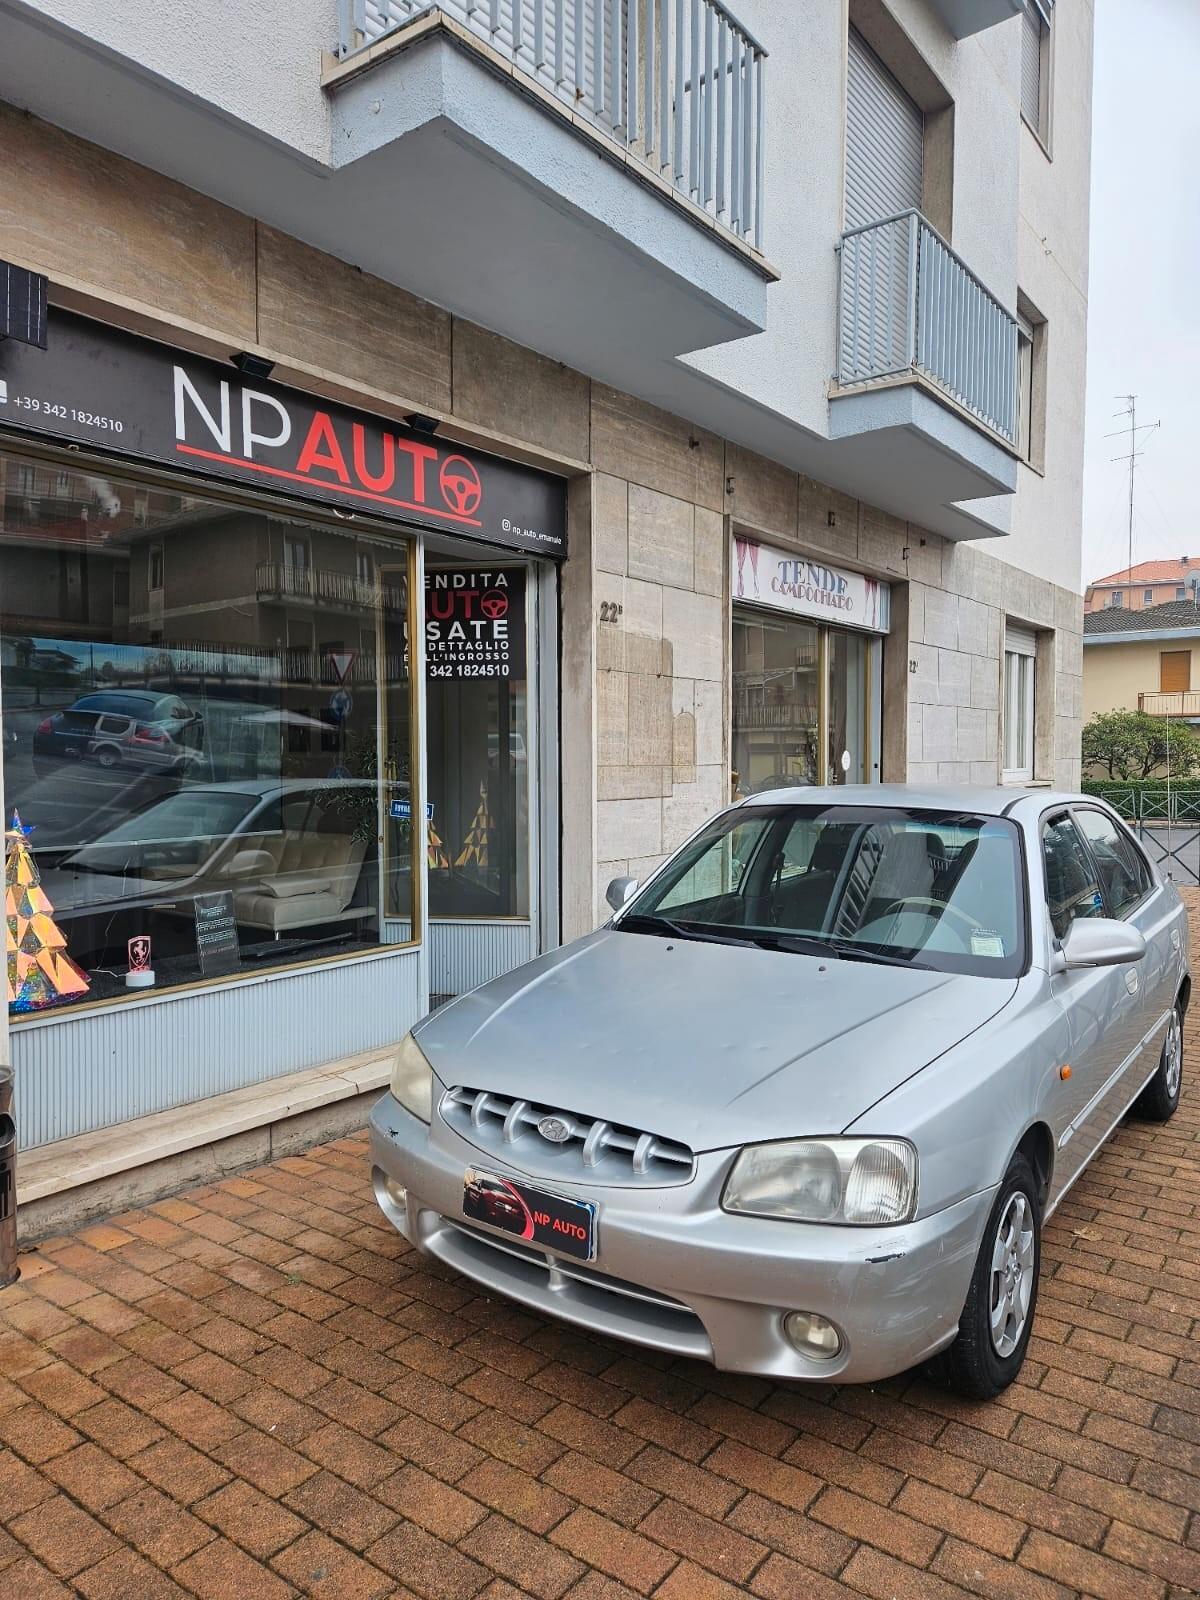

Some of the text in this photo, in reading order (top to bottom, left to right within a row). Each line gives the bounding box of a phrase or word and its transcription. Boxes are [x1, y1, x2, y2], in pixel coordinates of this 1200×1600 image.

[13, 396, 123, 432] +39 342 1824510
[777, 560, 848, 594] TENDE
[424, 589, 509, 619] UTO
[428, 641, 509, 651] DETTAGLIO
[430, 664, 509, 677] 342 1824510
[534, 1212, 586, 1239] NP AUTO
